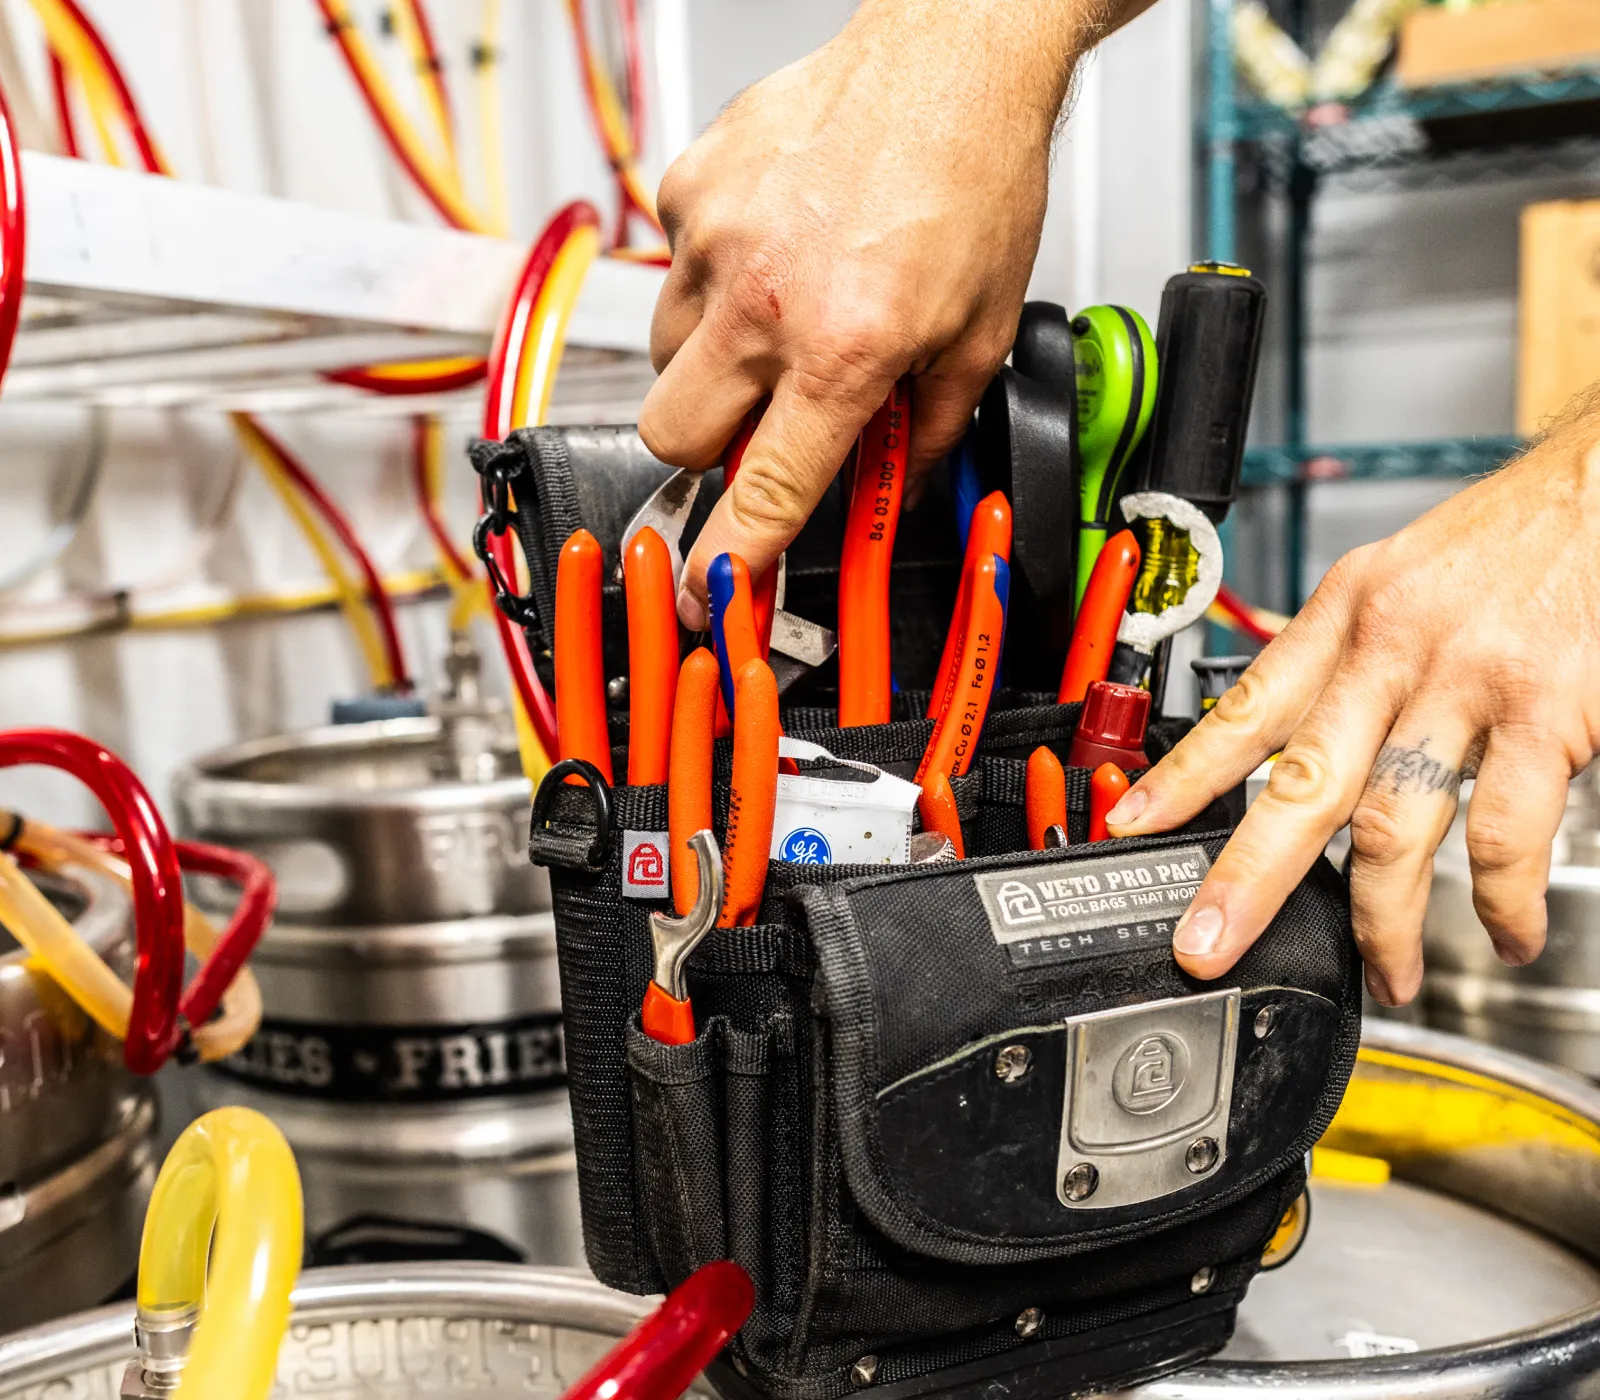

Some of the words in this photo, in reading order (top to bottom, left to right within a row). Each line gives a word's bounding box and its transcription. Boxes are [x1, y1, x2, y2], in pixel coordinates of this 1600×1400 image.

[888, 411, 903, 429] 68
[878, 460, 896, 490] 300
[874, 497, 890, 516] 03
[869, 521, 886, 541] 86
[972, 673, 984, 689] Fe
[979, 633, 991, 652] 1,2
[1036, 875, 1100, 899] VETO
[1105, 867, 1152, 890] PRO
[1129, 891, 1164, 906] THAT
[1018, 934, 1094, 954] TECH
[1117, 920, 1179, 939] SER
[236, 1033, 333, 1087] IES
[391, 1024, 567, 1087] FRIE
